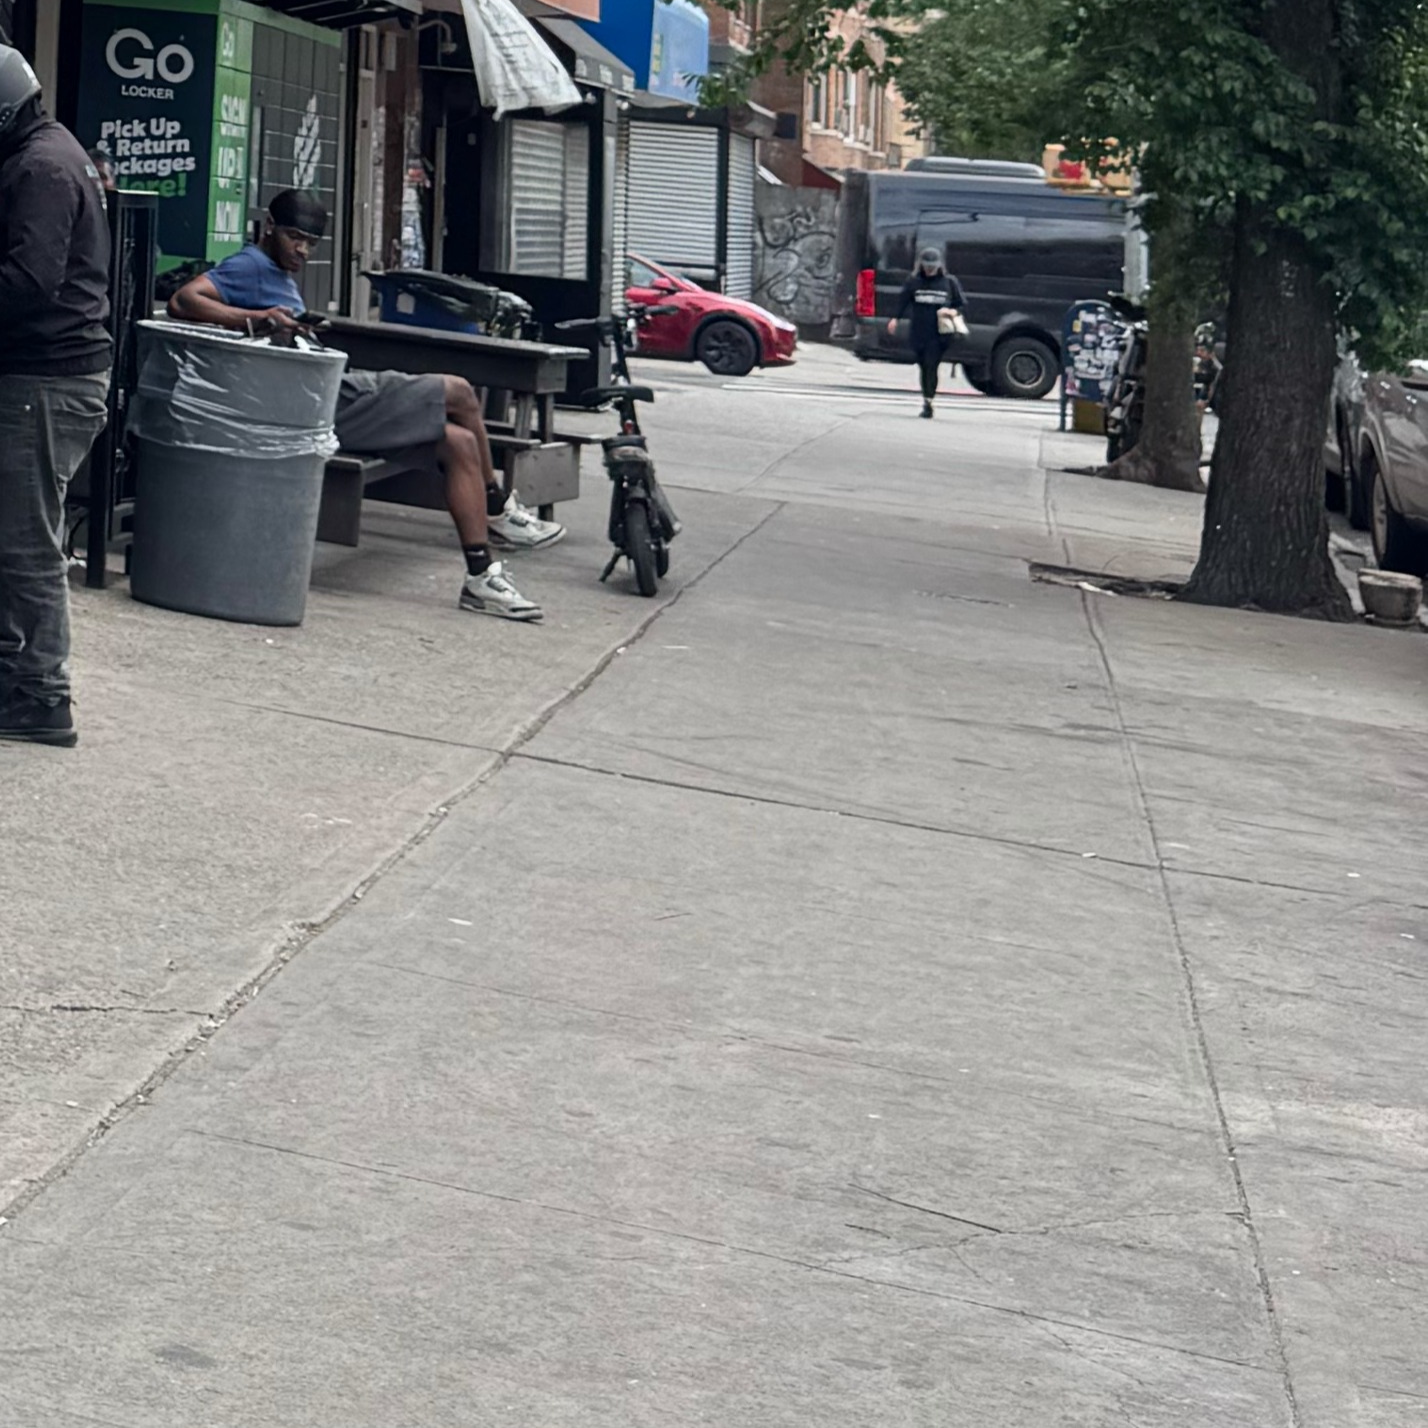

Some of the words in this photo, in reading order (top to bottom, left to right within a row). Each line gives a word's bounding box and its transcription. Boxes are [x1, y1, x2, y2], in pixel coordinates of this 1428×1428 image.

[121, 84, 174, 100] LOCKER
[101, 119, 146, 139] Pick
[150, 118, 180, 139] Up
[116, 139, 190, 156] Return
[114, 156, 196, 177] ckages
